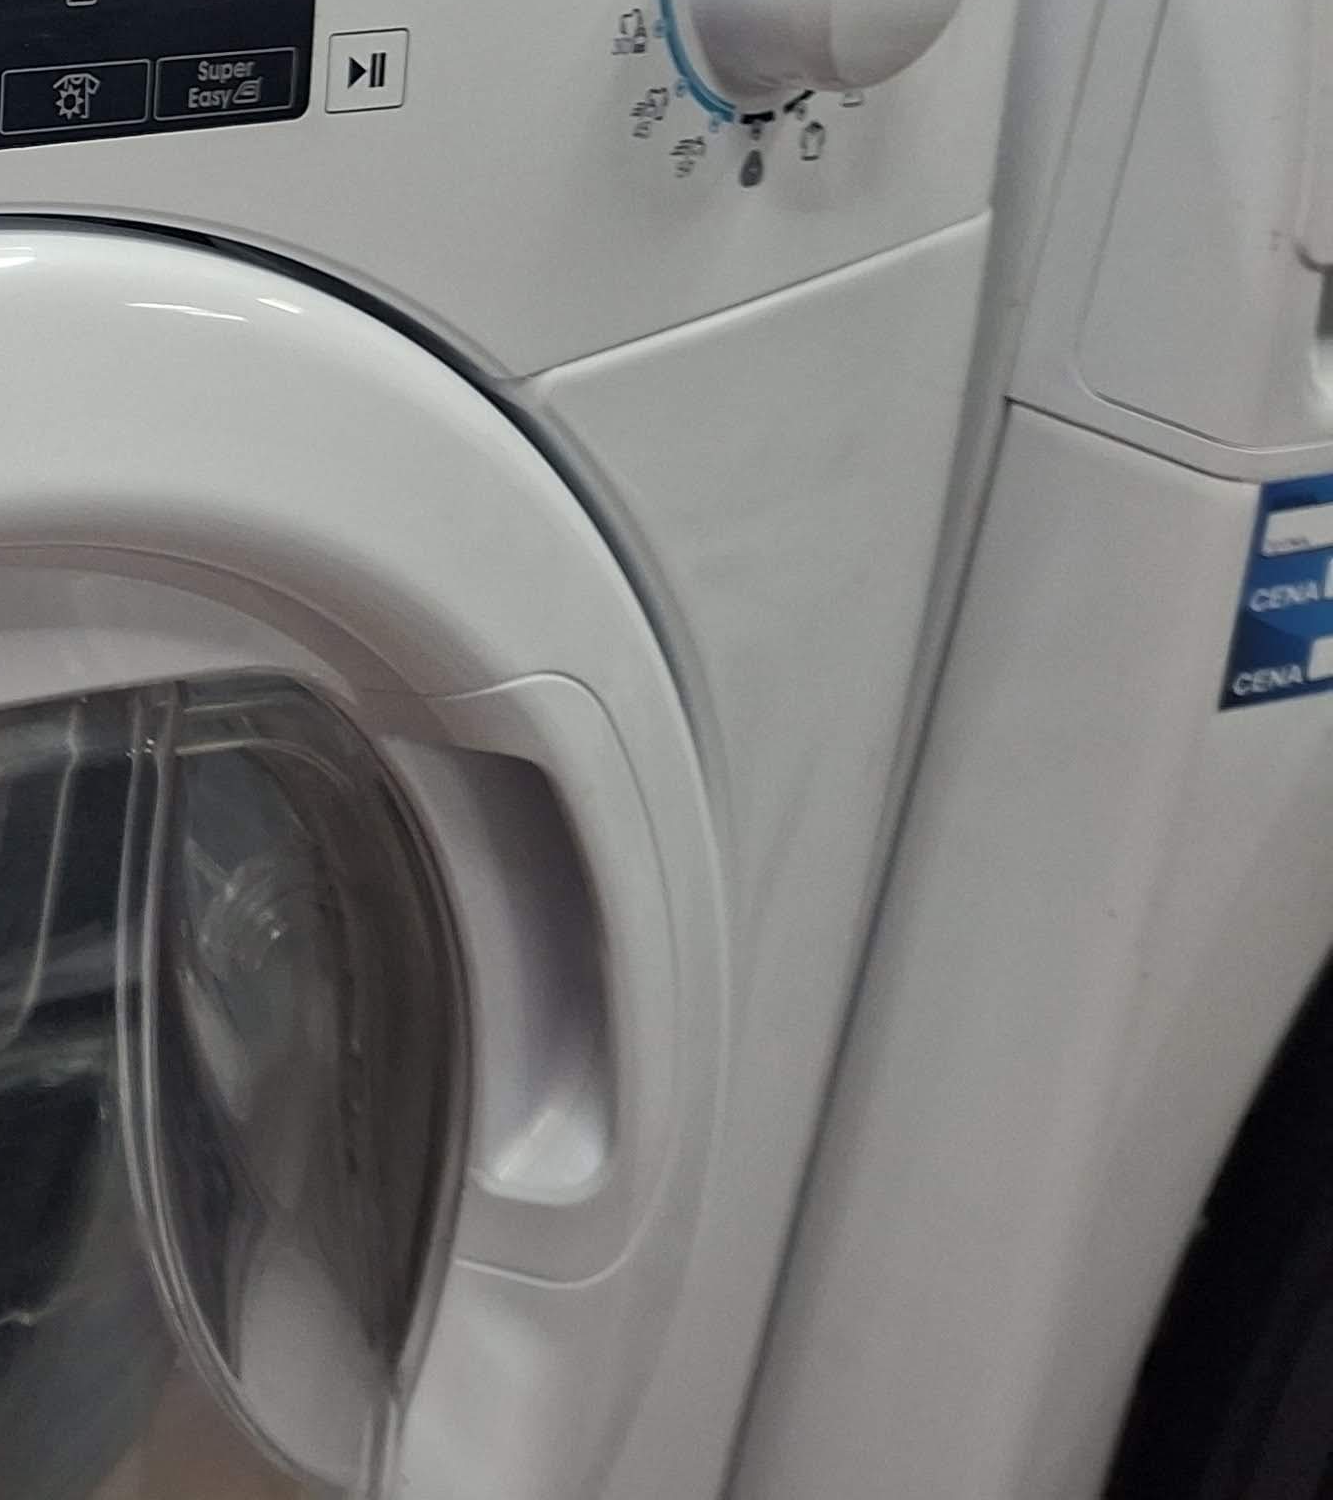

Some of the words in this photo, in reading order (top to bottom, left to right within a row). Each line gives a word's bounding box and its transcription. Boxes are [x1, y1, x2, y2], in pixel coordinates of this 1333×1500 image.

[197, 60, 255, 84] Super
[188, 87, 233, 109] Easy
[1249, 580, 1318, 612] CENA
[1233, 663, 1304, 696] CENA
